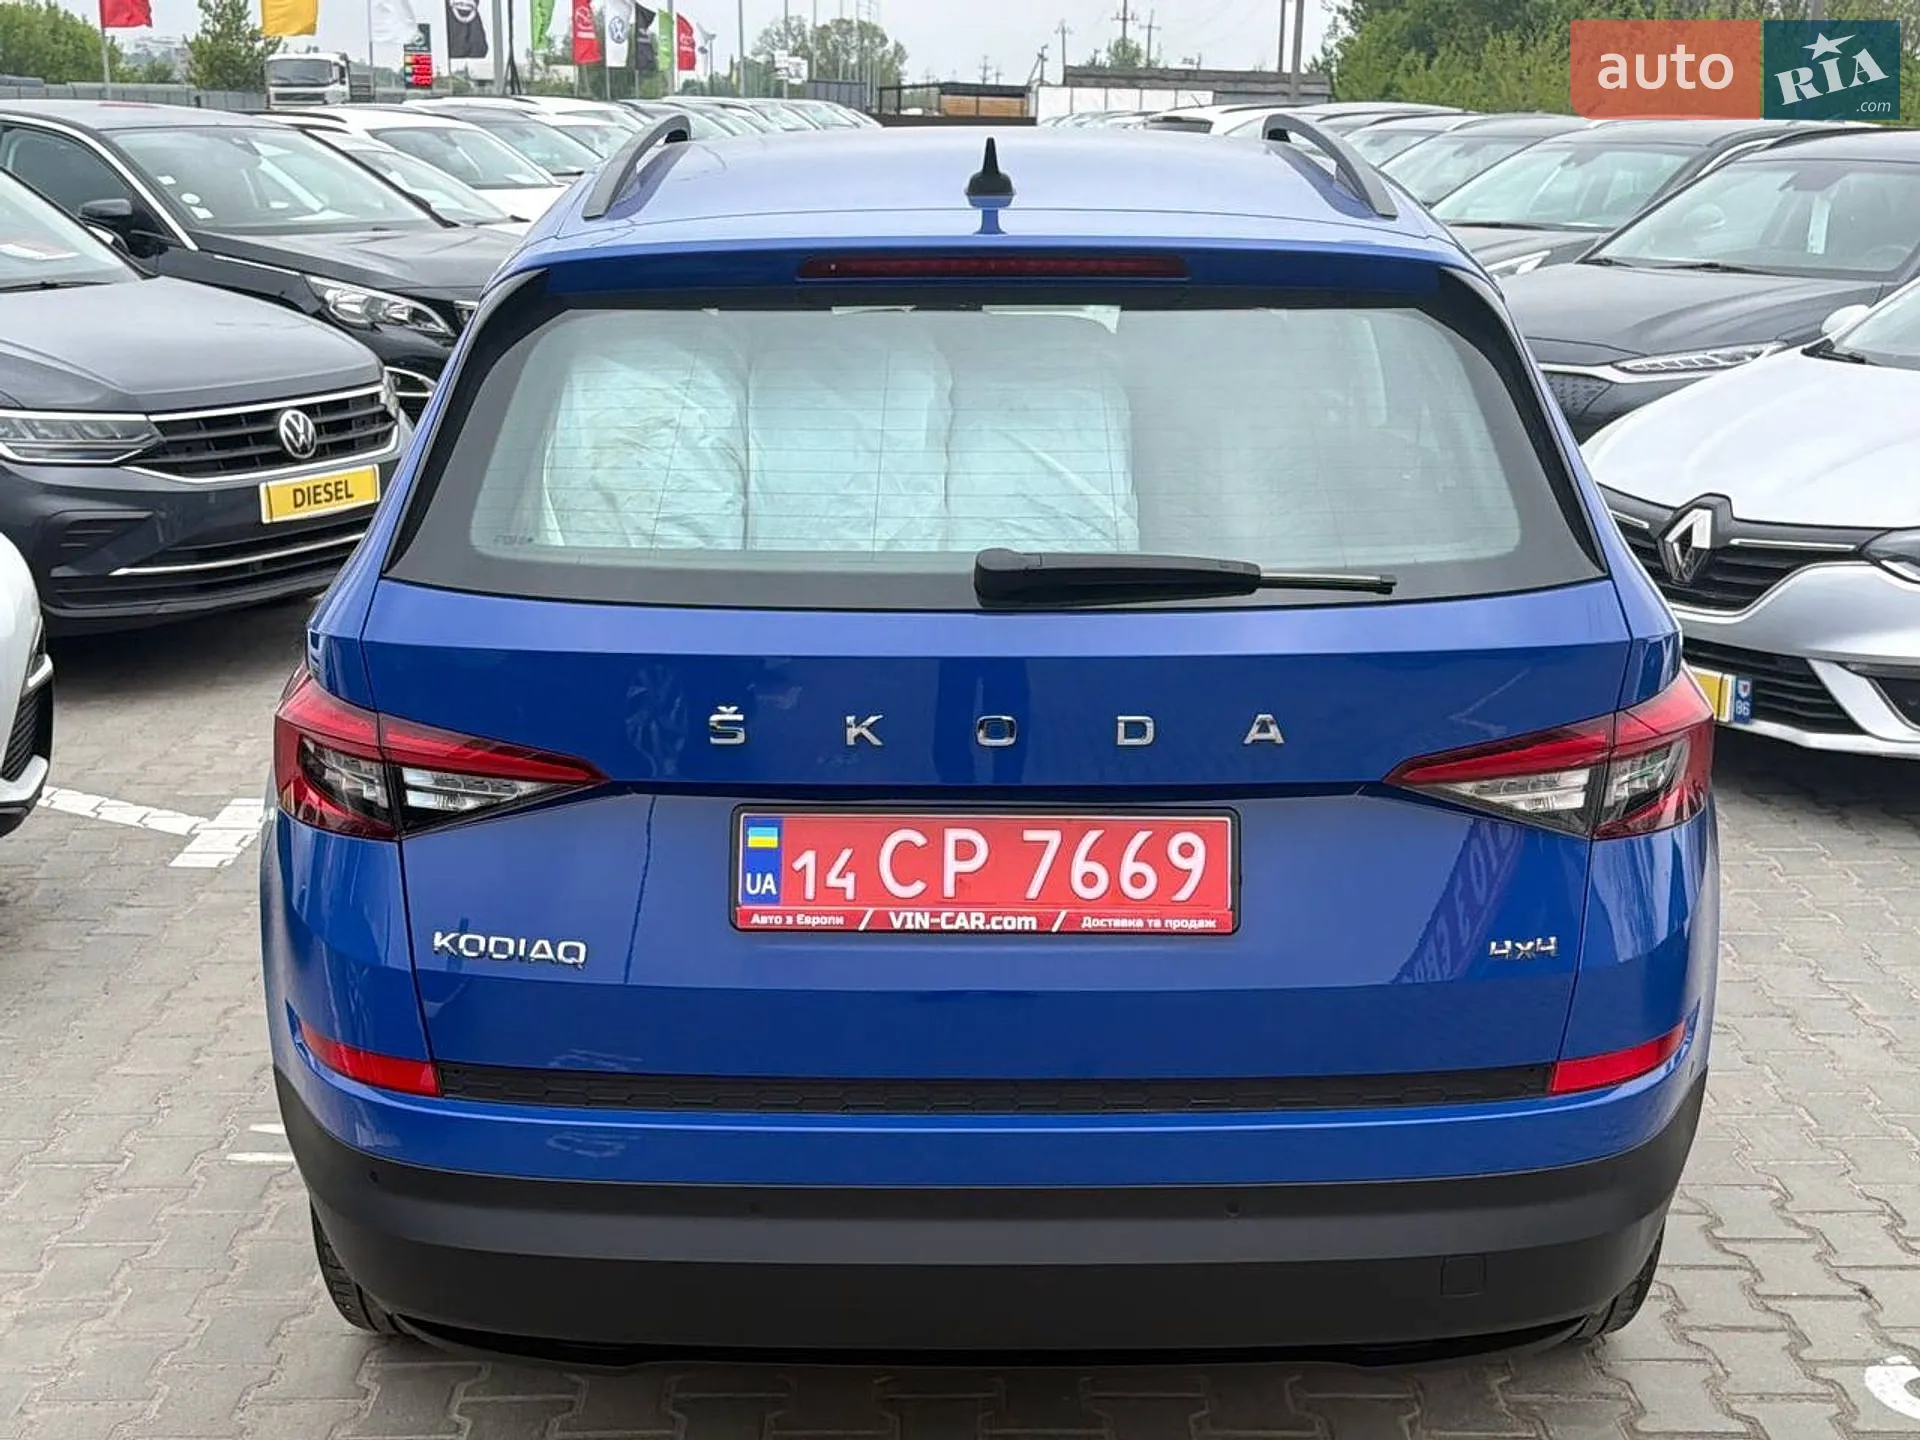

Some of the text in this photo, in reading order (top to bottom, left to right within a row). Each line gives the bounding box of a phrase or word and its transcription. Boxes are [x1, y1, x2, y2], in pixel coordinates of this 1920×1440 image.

[292, 479, 355, 509] DIESEL
[791, 826, 1208, 903] 14 CP 7669
[745, 873, 777, 895] UA
[750, 913, 782, 925] Авто
[889, 911, 1037, 930] VIN-CAR.com
[1081, 915, 1216, 930] Доставка та продаж
[433, 931, 587, 970] KODIAQ
